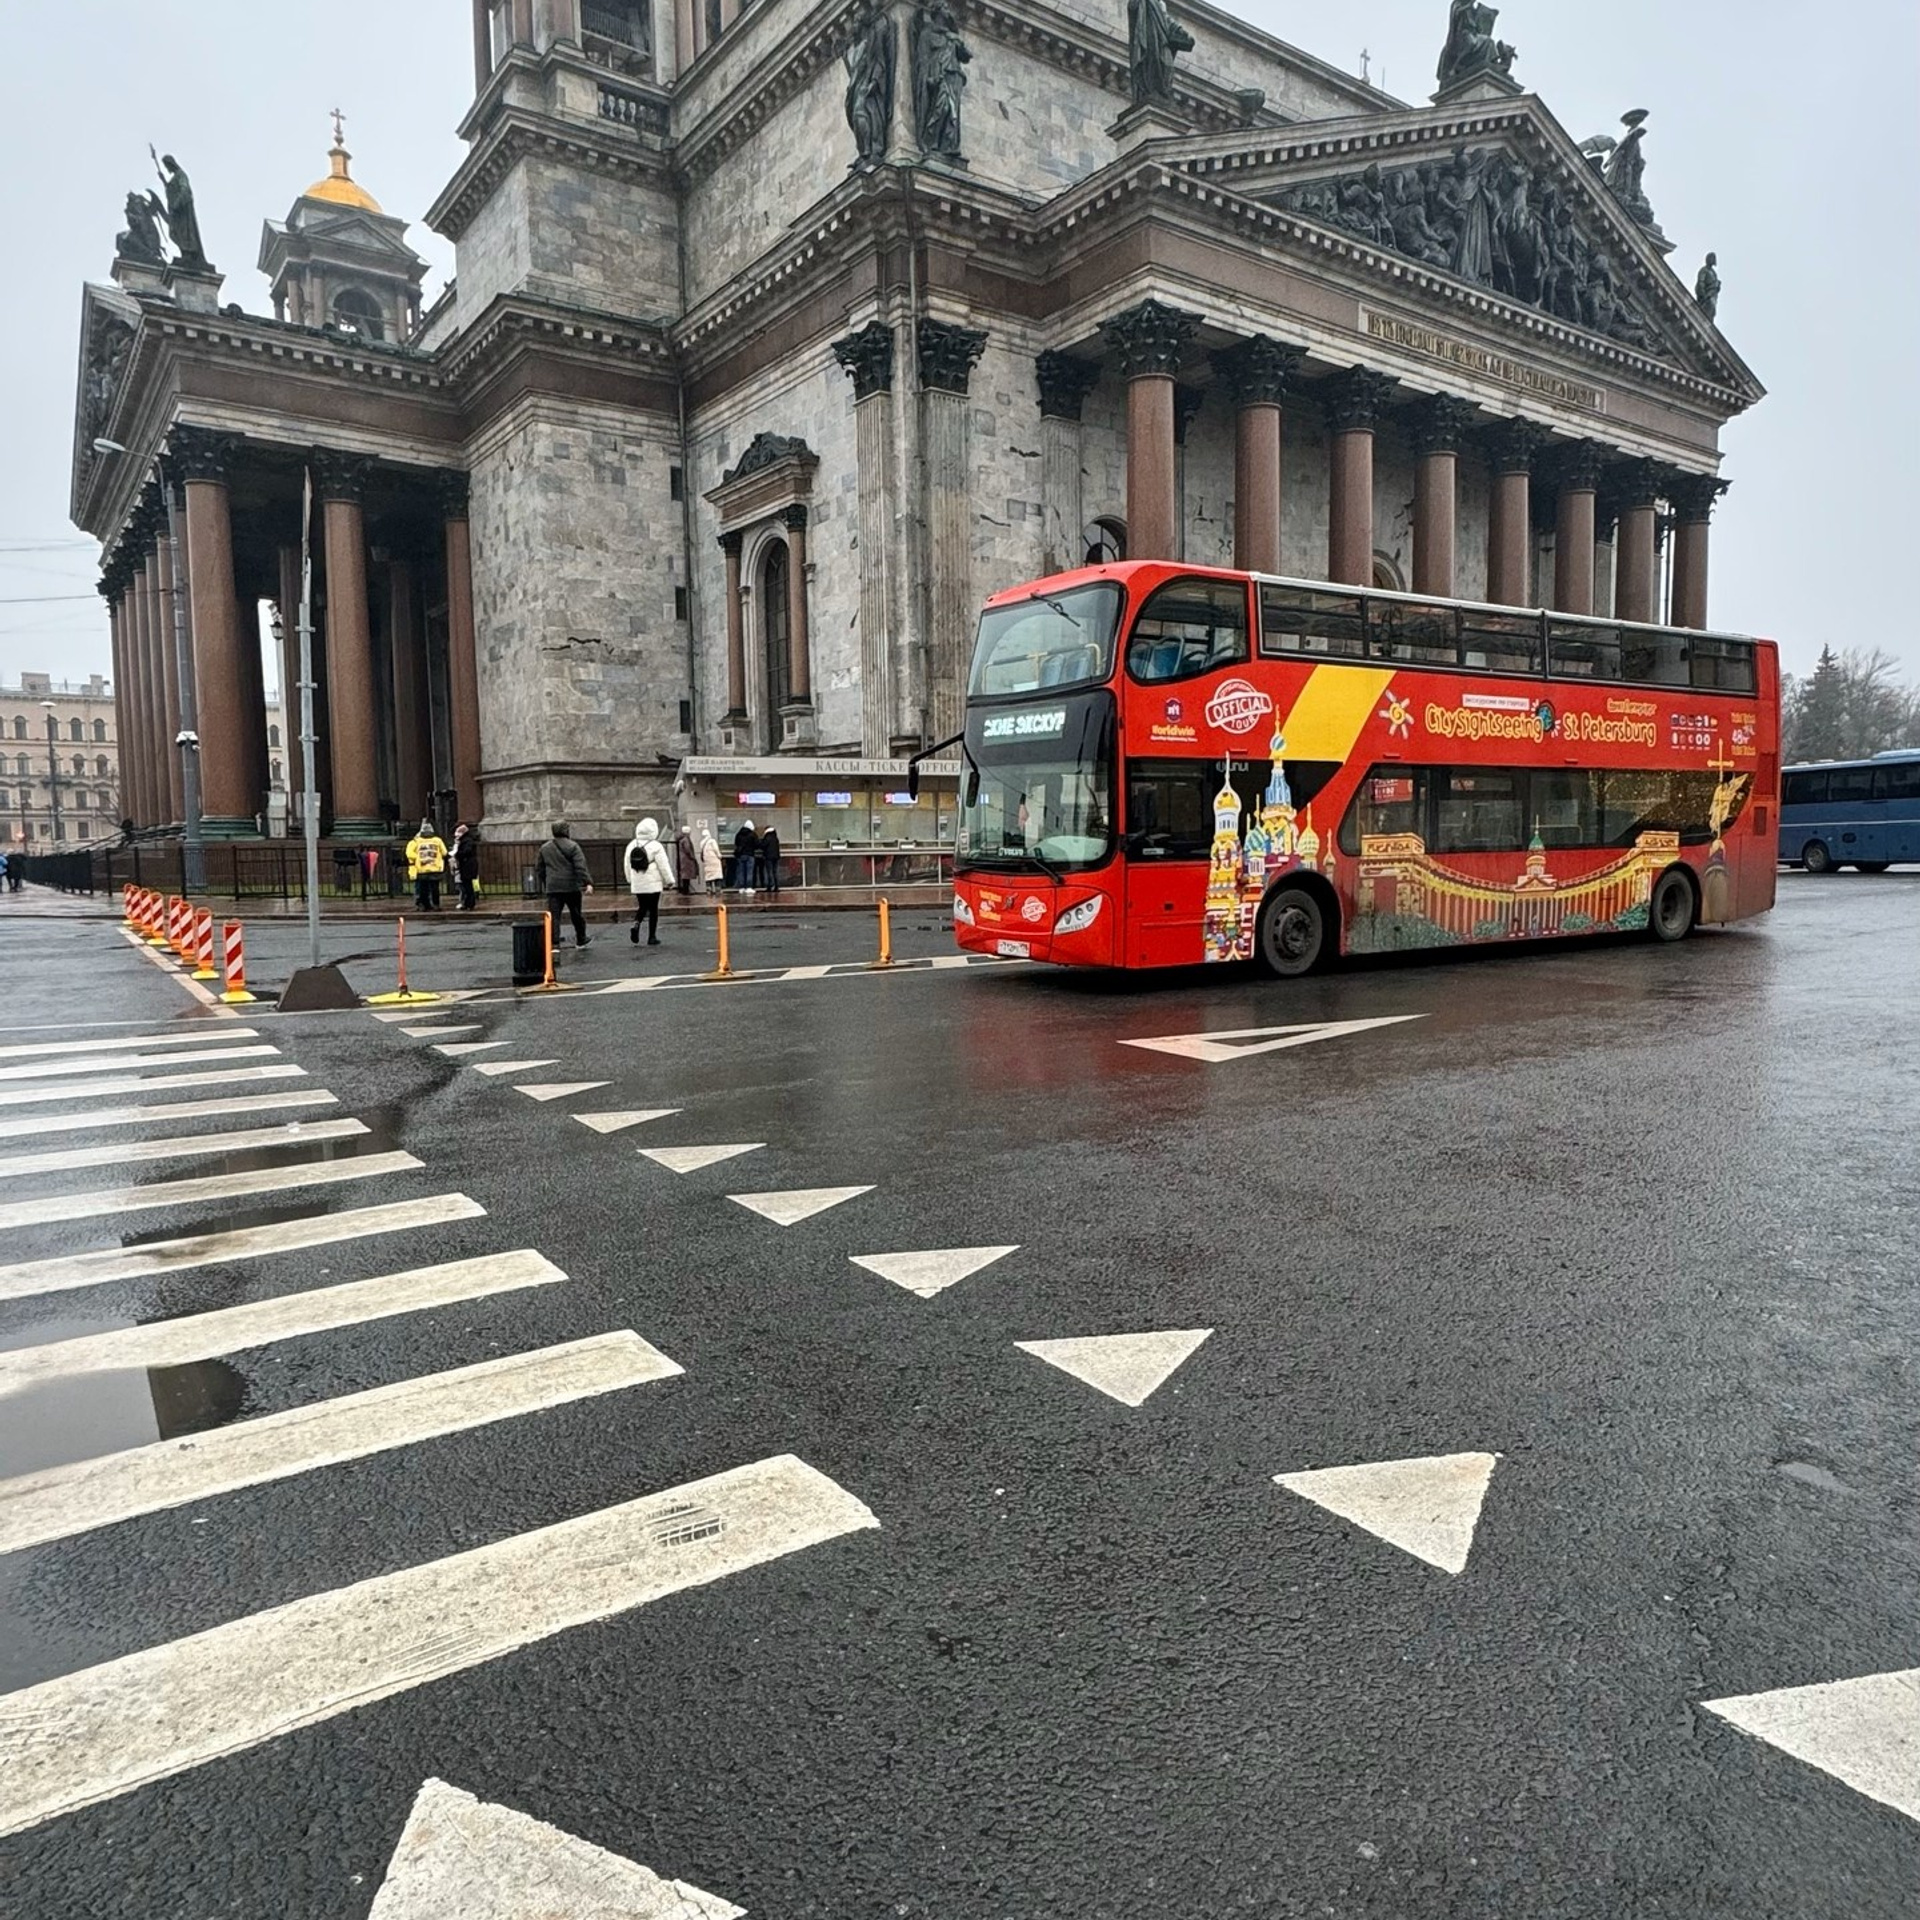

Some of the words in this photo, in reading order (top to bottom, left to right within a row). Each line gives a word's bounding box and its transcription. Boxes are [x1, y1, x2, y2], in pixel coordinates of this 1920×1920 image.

[1213, 697, 1268, 720] OFFICIAL
[1231, 715, 1256, 729] TOUR
[1425, 703, 1544, 743] CitySightseeing
[1563, 712, 1580, 740] St
[1581, 712, 1656, 747] Petersburg
[815, 760, 860, 772] КАССЫ
[869, 761, 908, 772] TICKE
[918, 761, 958, 773] OFFICE
